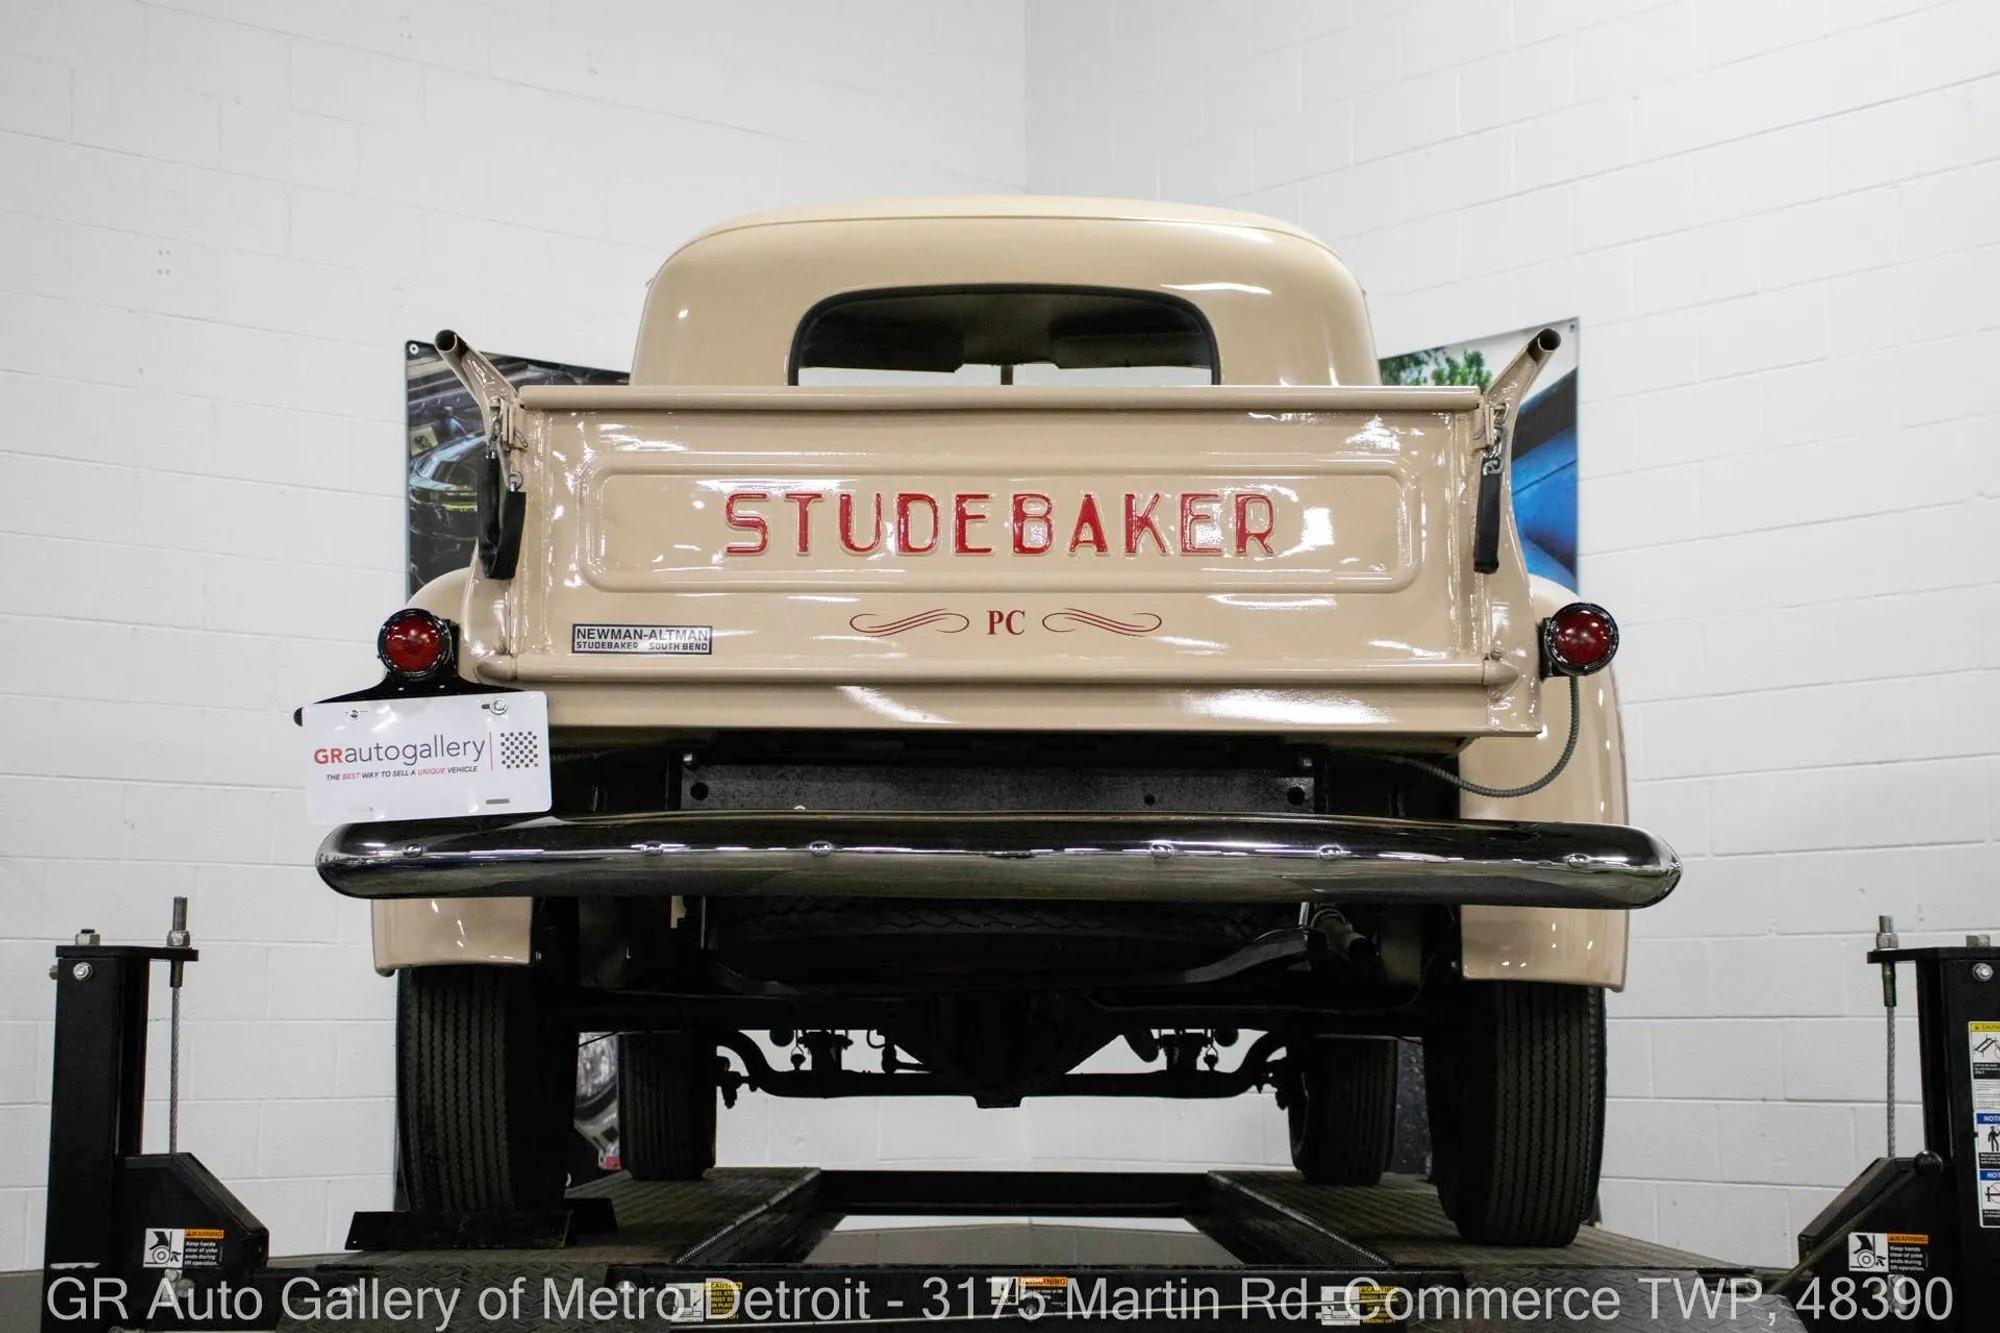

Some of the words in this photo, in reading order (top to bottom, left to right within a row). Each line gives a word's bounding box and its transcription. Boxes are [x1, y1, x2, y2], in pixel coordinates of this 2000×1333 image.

[725, 492, 1275, 556] STUDEBAKER
[987, 610, 1025, 636] PC
[576, 628, 708, 641] NEWMAN-ALTMAN
[576, 642, 639, 650] STUDEBAKER
[649, 642, 680, 651] SOUTH
[682, 643, 708, 651] BEND
[314, 734, 486, 766] GRautogallery
[342, 772, 361, 780] BEST
[362, 771, 380, 779] WAY
[381, 770, 392, 778] TO
[393, 769, 409, 777] SELL
[417, 767, 446, 776] UNIQUE
[446, 765, 478, 774] VEHICLE
